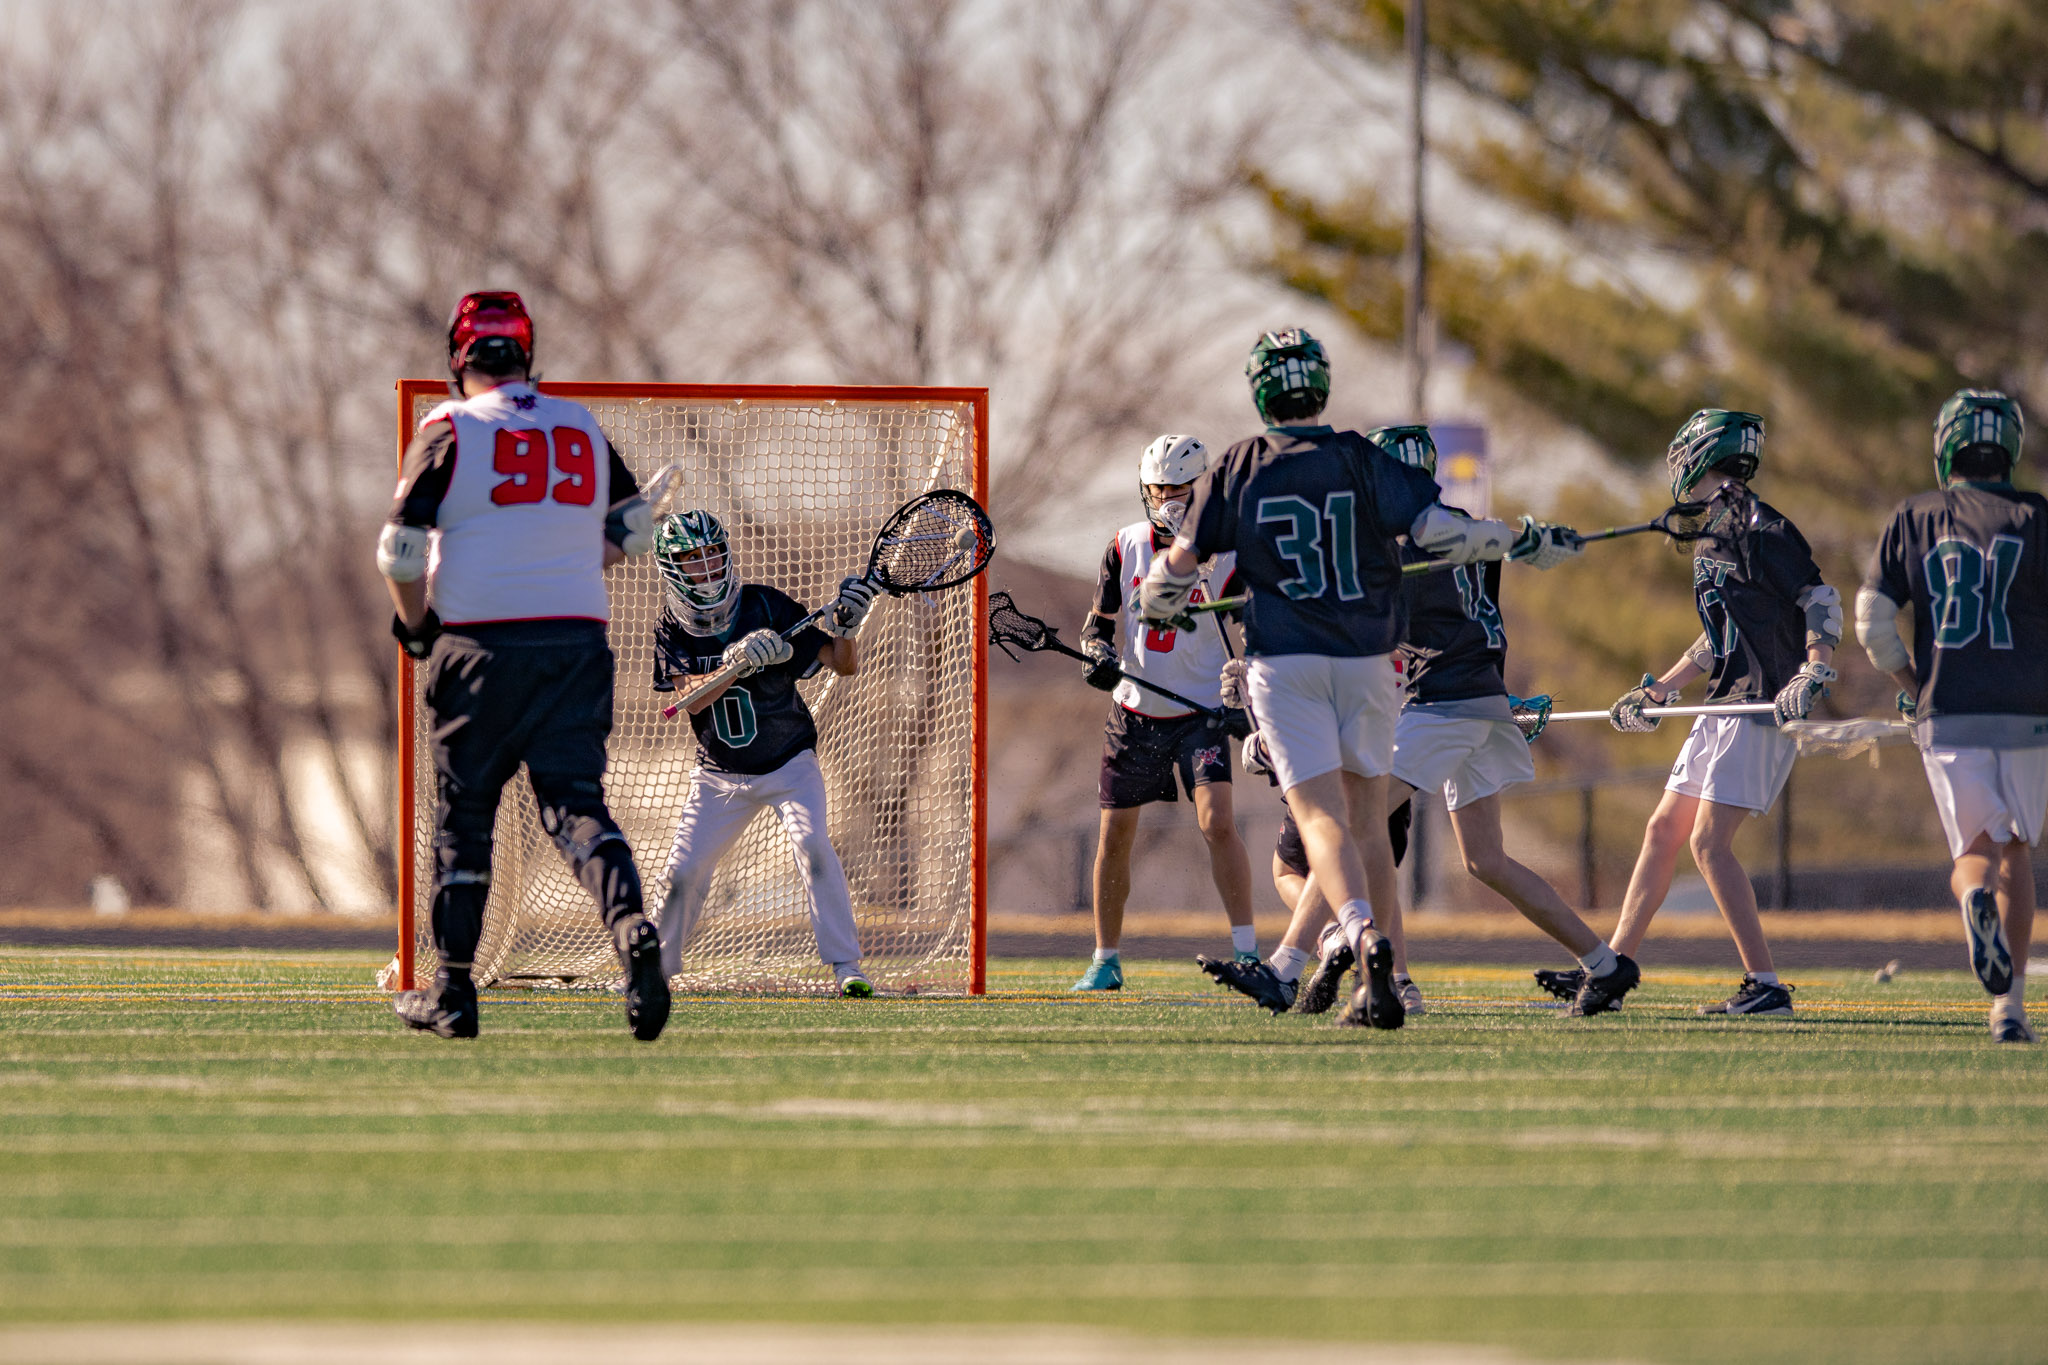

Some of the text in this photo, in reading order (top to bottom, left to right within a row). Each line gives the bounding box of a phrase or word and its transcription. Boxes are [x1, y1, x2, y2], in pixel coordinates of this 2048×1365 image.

[491, 425, 595, 507] 99
[1256, 490, 1364, 602] 31
[1923, 534, 2024, 649] 81
[711, 685, 758, 749] 0
